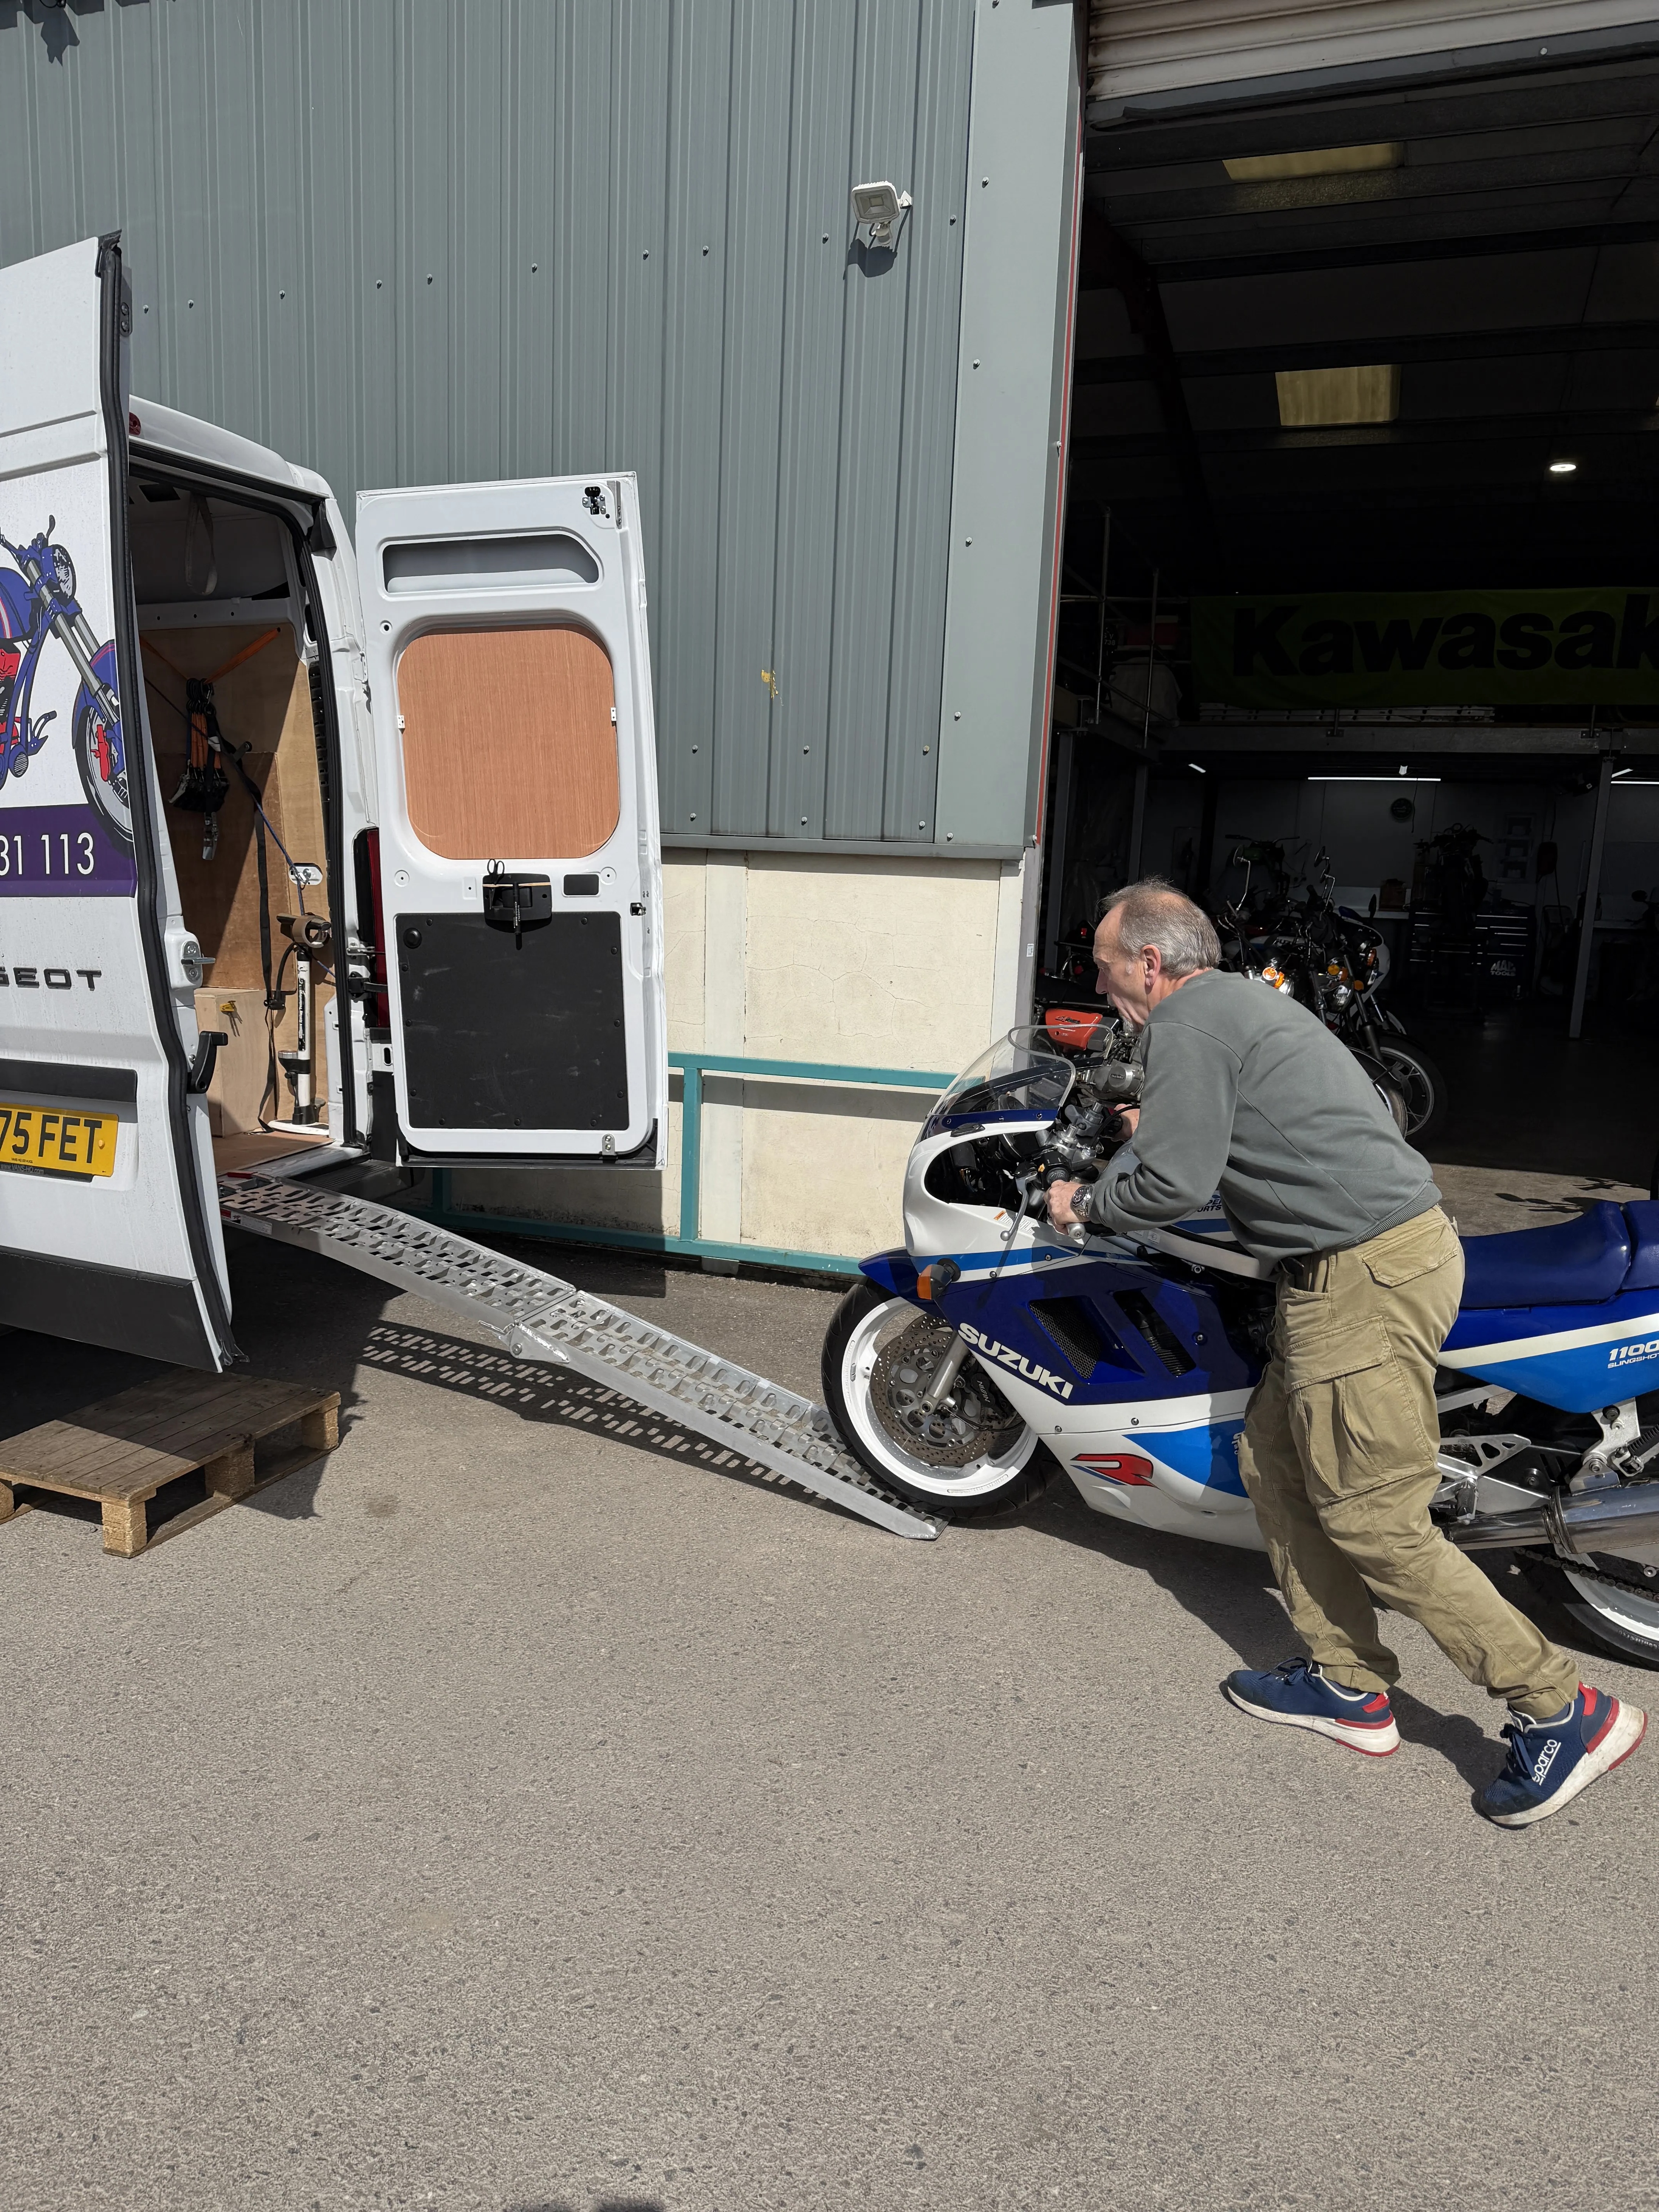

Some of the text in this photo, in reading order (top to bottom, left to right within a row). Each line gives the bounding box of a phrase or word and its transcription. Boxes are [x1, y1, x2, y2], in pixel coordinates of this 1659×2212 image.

[41, 832, 94, 874] 113
[38, 1114, 102, 1163] FET
[958, 1323, 1073, 1399] SUZUKI
[1609, 1340, 1659, 1361] 1100
